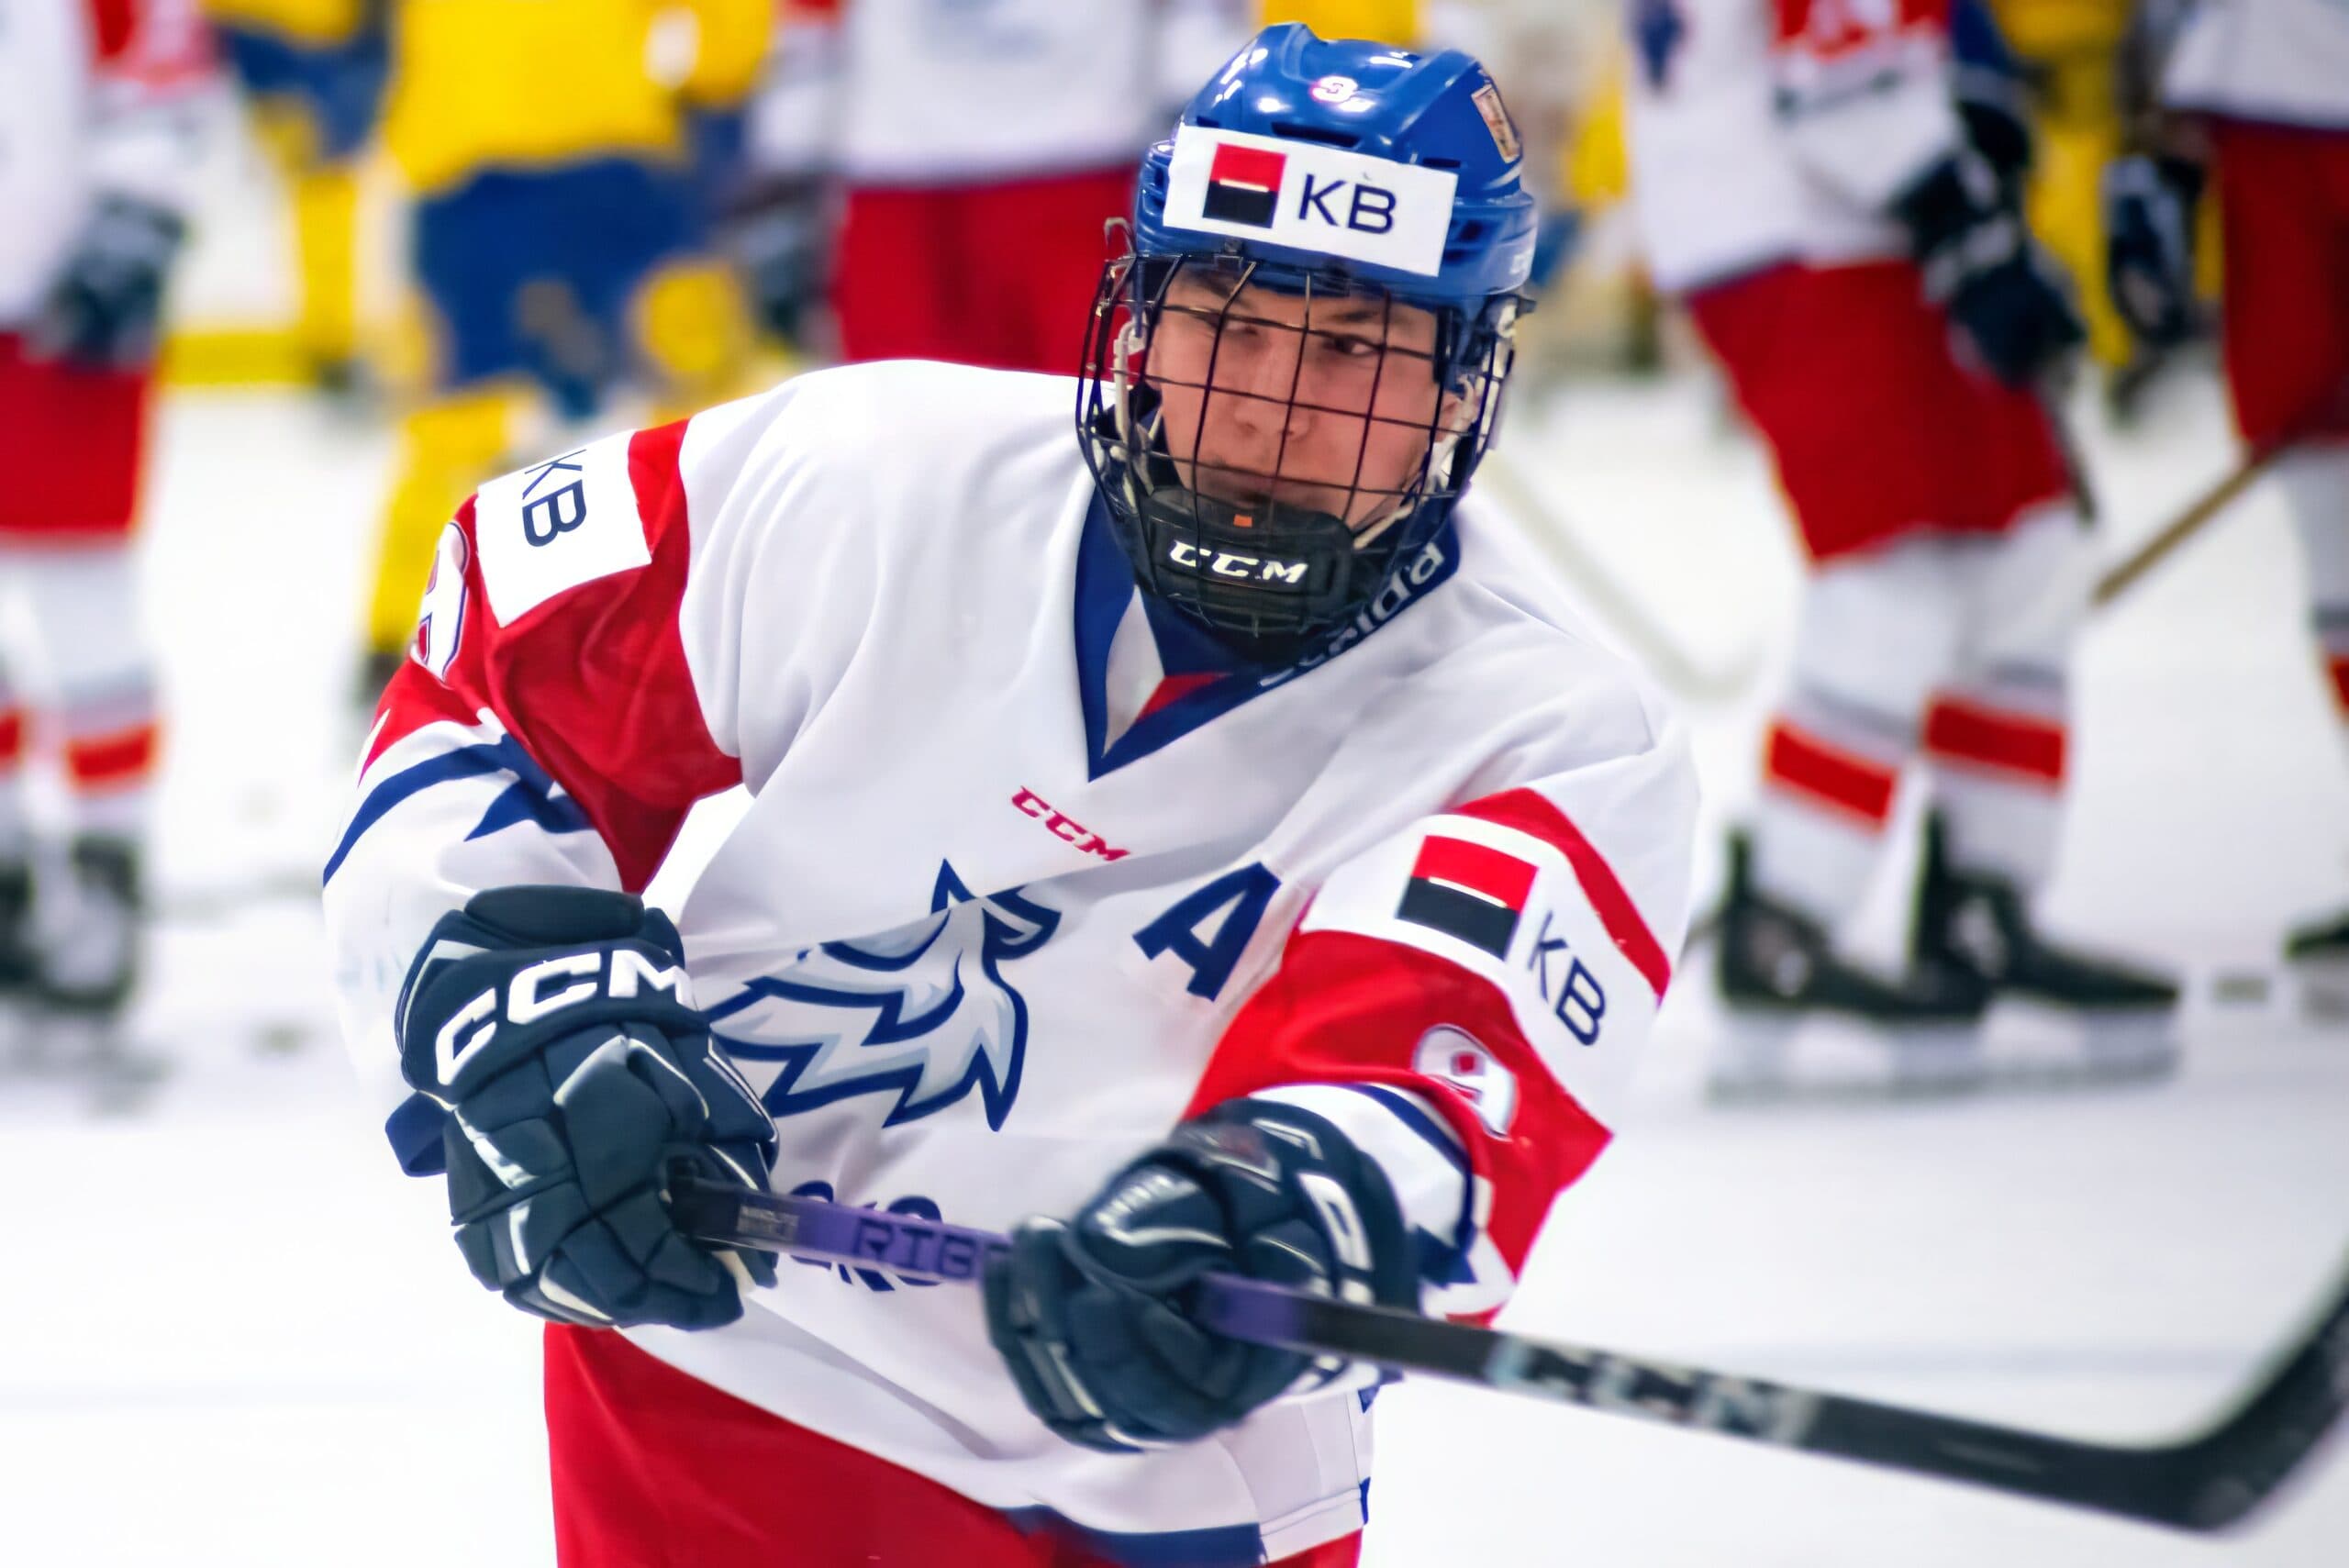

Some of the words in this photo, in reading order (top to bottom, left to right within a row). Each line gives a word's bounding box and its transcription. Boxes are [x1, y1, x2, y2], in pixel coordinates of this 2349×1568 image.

[1297, 172, 1397, 236] KB
[521, 448, 588, 548] KB
[1169, 539, 1309, 584] CCM
[1011, 784, 1130, 862] CCM
[1132, 861, 1283, 1002] A
[1527, 910, 1608, 1047] KB
[435, 949, 703, 1086] CCM
[853, 1216, 1013, 1281] RIB
[1483, 1332, 1821, 1446] CCM
